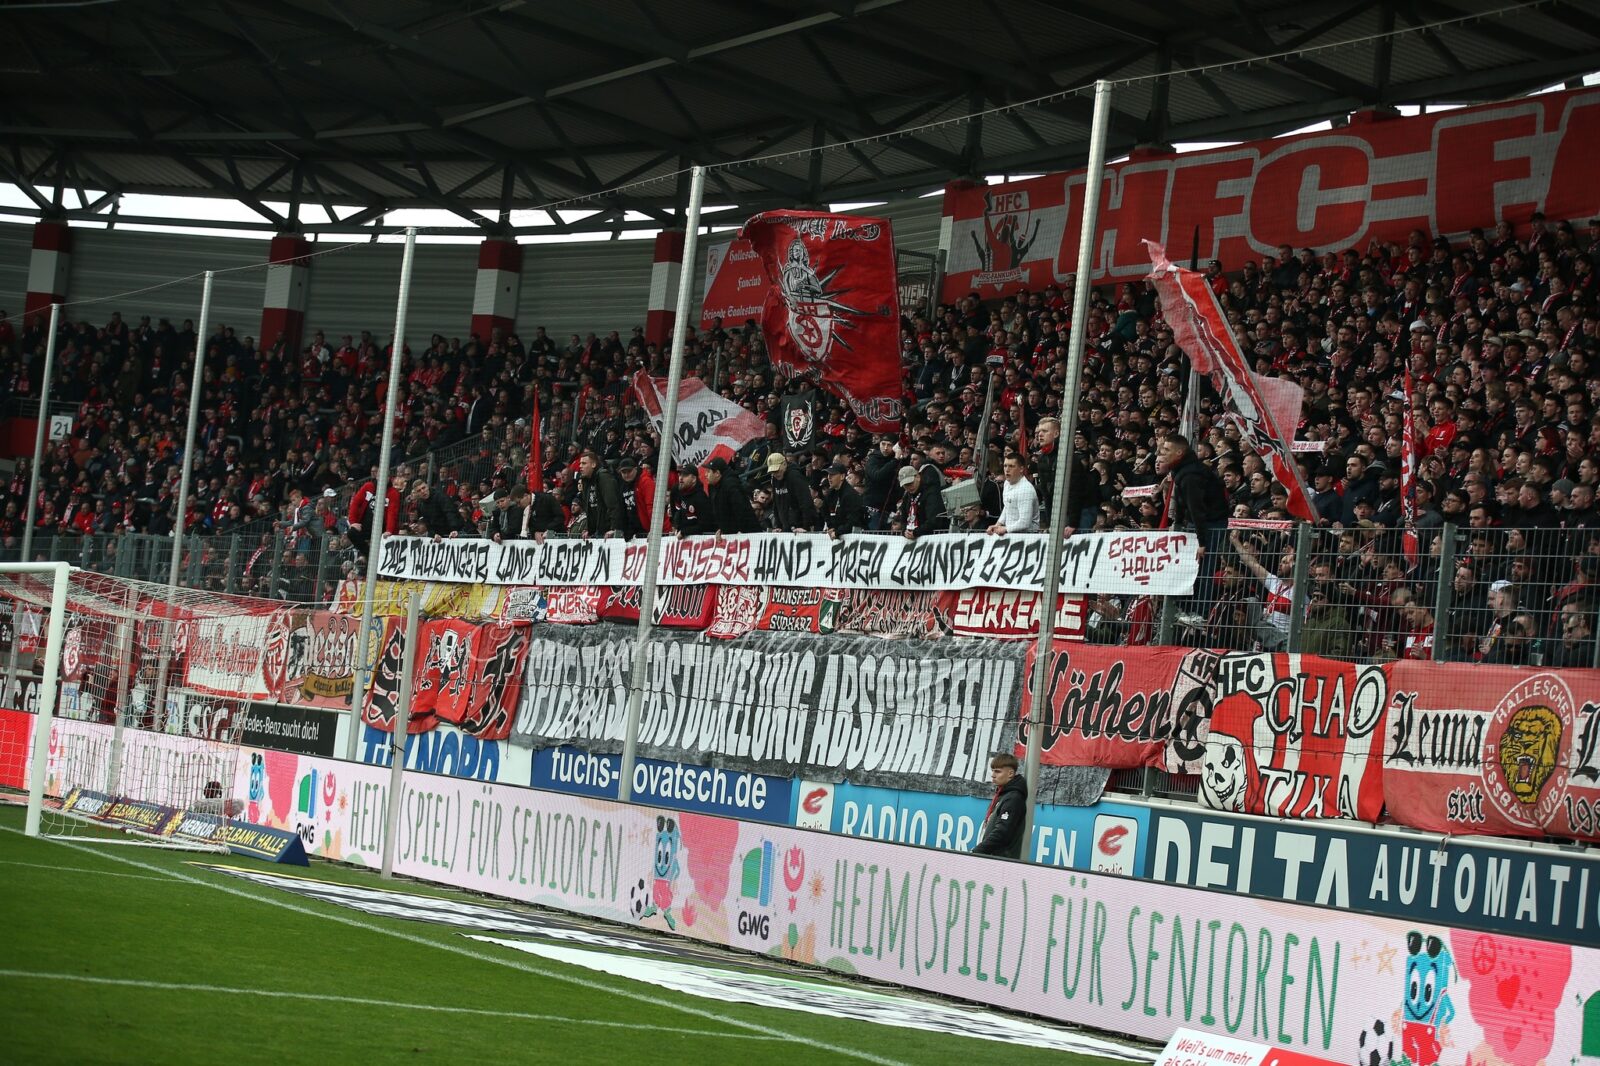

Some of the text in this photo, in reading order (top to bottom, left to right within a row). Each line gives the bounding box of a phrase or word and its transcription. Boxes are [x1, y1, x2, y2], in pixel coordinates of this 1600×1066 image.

[995, 192, 1023, 212] HFC
[53, 421, 70, 436] 21
[380, 538, 408, 575] DAS
[410, 538, 490, 584] THÜRINGER
[496, 543, 536, 582] LAND
[538, 541, 594, 582] BLEIBT
[620, 538, 750, 582] RO-WEISSER
[753, 538, 812, 581] HAND
[825, 539, 888, 586] FORZA
[890, 539, 985, 586] GRANDE
[1108, 534, 1187, 559] ERFURT
[772, 587, 821, 606] MANSFELD
[769, 612, 813, 631] SÜDHARZ
[1189, 650, 1220, 681] HF
[1216, 658, 1265, 699] HFC
[1496, 679, 1571, 729] HALLESCHER
[281, 719, 301, 739] sucht
[301, 721, 320, 741] dich!
[1386, 690, 1486, 769] Leuna
[550, 748, 768, 810] fuchs-ovatsch.de
[1446, 782, 1486, 823] seit
[178, 819, 216, 839] MERKUR
[256, 833, 289, 853] HALLE
[467, 786, 502, 880] FÜR
[508, 804, 624, 902] SENIOREN
[841, 801, 1077, 869] RADIO BREN
[1368, 843, 1600, 930] AUTOMATI
[737, 910, 770, 941] GWG
[1042, 875, 1108, 1007] FÜR
[1120, 904, 1342, 1050] SENIOREN
[1176, 1037, 1252, 1065] Weil's um mehr
